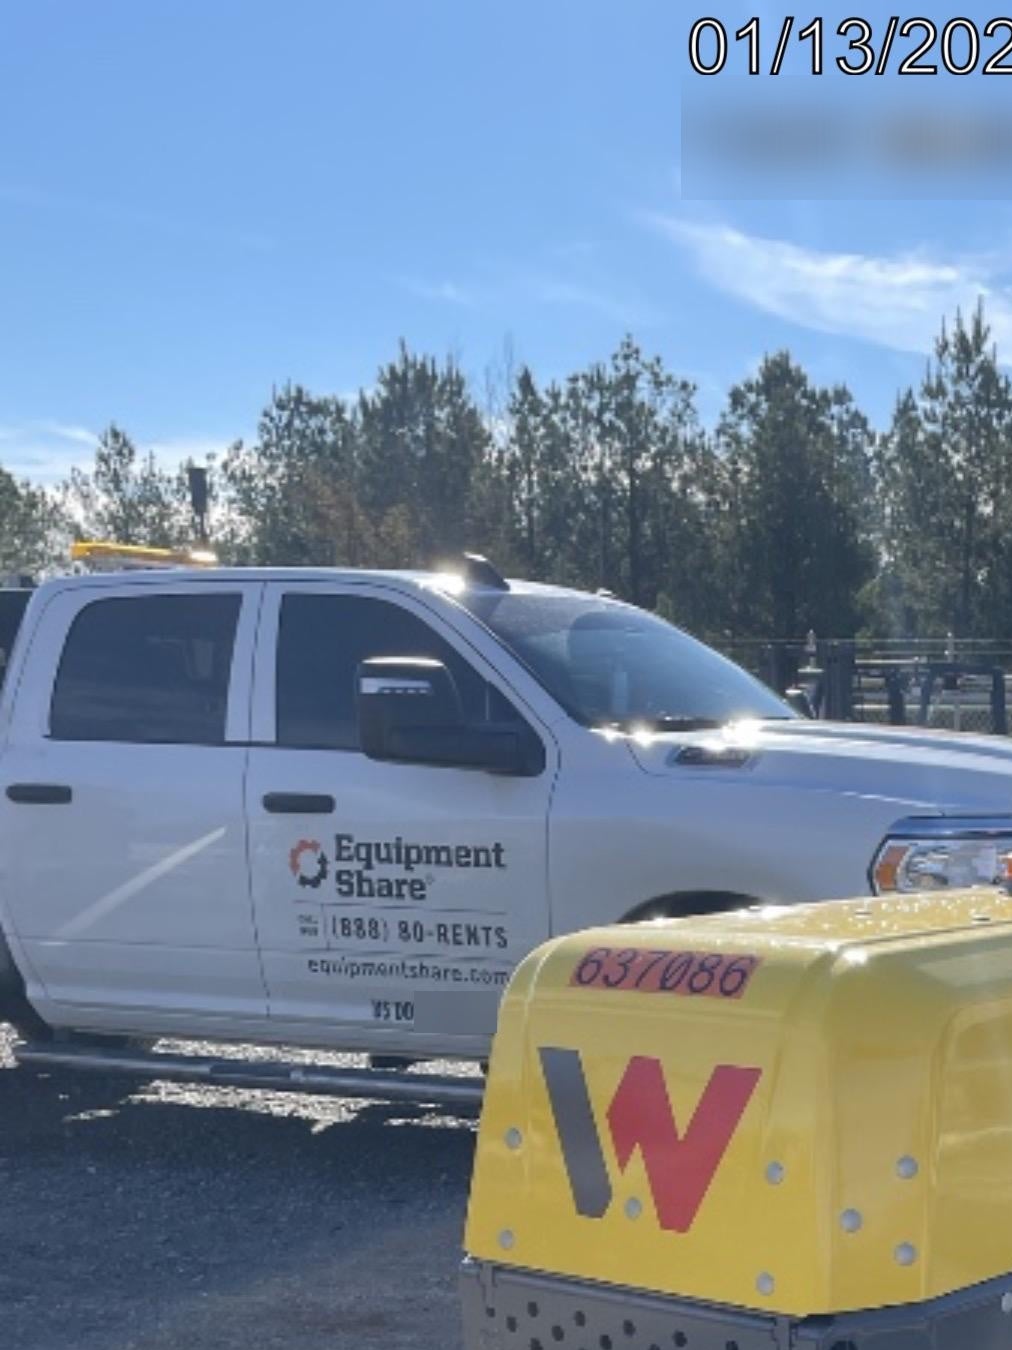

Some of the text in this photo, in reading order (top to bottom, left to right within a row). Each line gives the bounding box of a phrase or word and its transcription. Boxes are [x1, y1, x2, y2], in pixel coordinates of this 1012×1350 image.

[334, 833, 507, 871] Equipment
[335, 869, 427, 901] Share
[332, 915, 387, 943] (888)
[398, 920, 508, 950] 80-RENTS
[307, 956, 511, 985] equipmentshare.com
[575, 947, 757, 996] 637086
